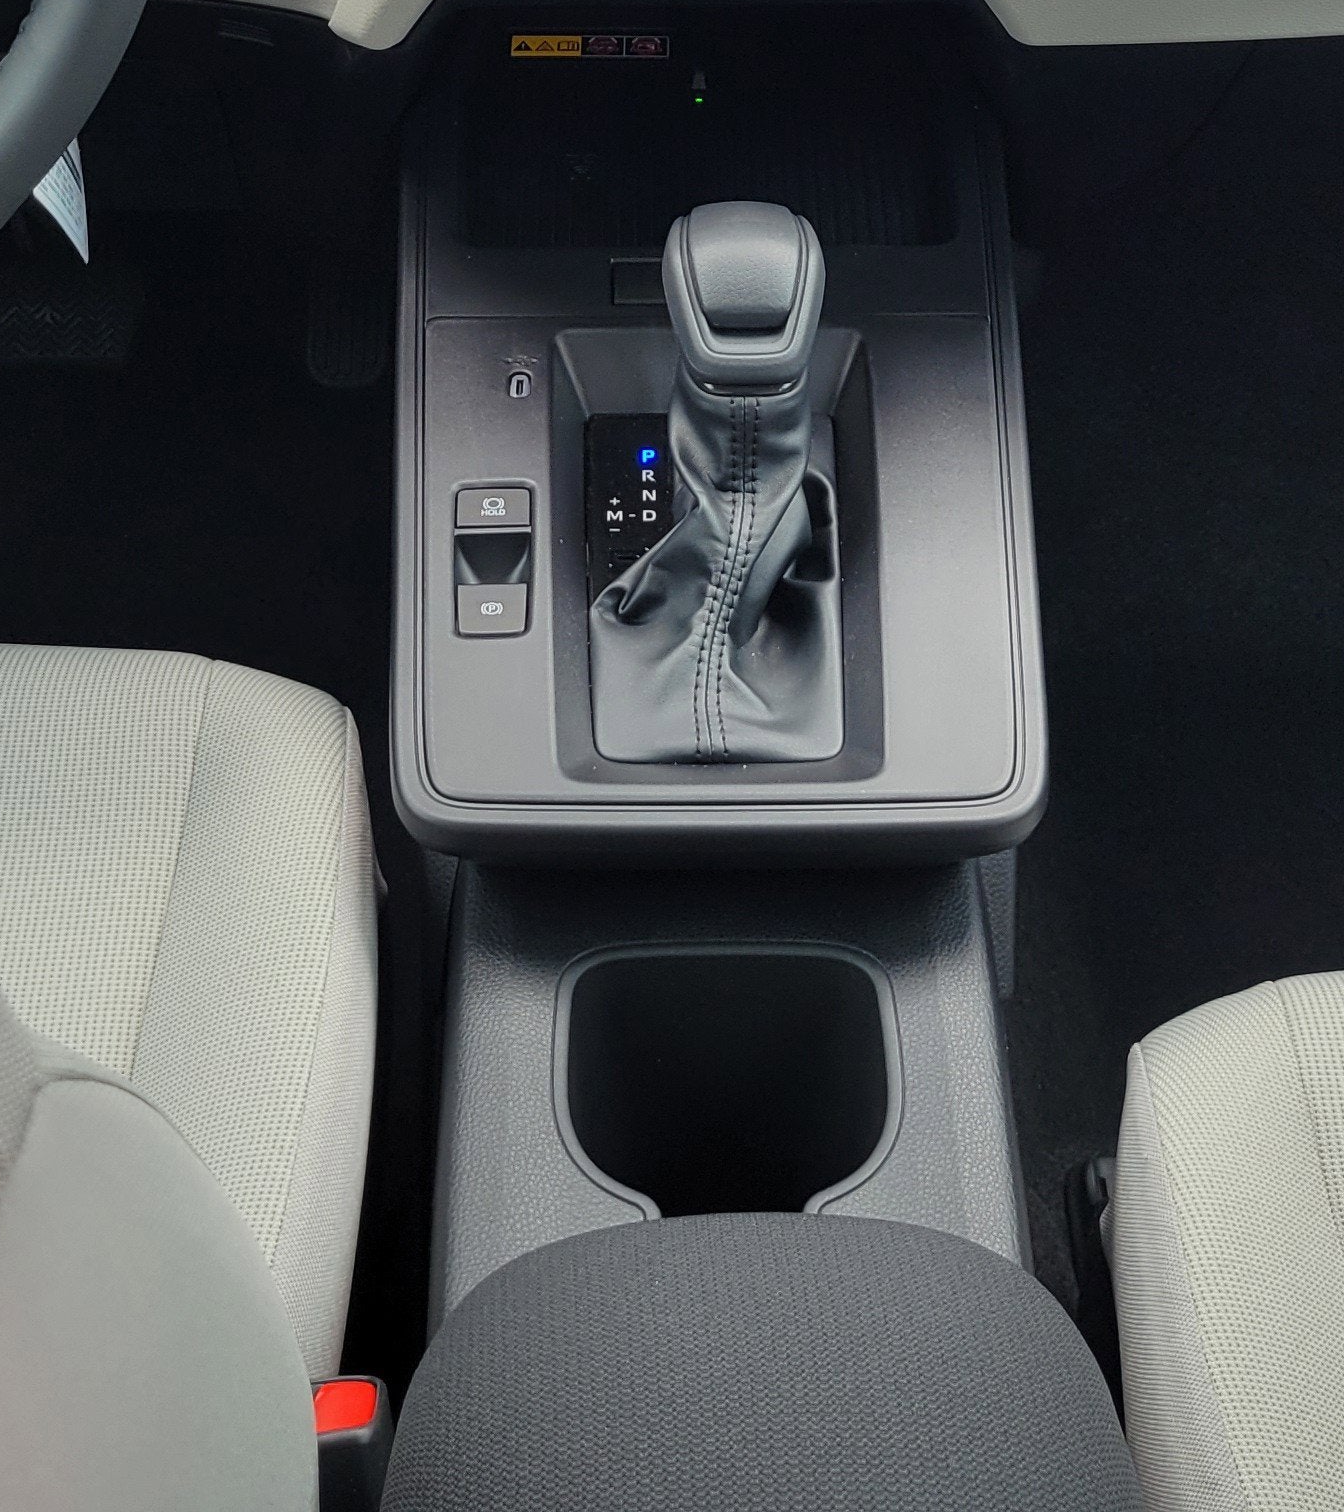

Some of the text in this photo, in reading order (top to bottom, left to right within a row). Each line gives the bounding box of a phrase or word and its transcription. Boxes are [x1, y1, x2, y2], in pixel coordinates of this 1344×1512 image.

[641, 448, 656, 463] P
[641, 469, 656, 483] R
[641, 489, 657, 502] N
[480, 509, 506, 517] HOLD
[606, 509, 657, 522] M D
